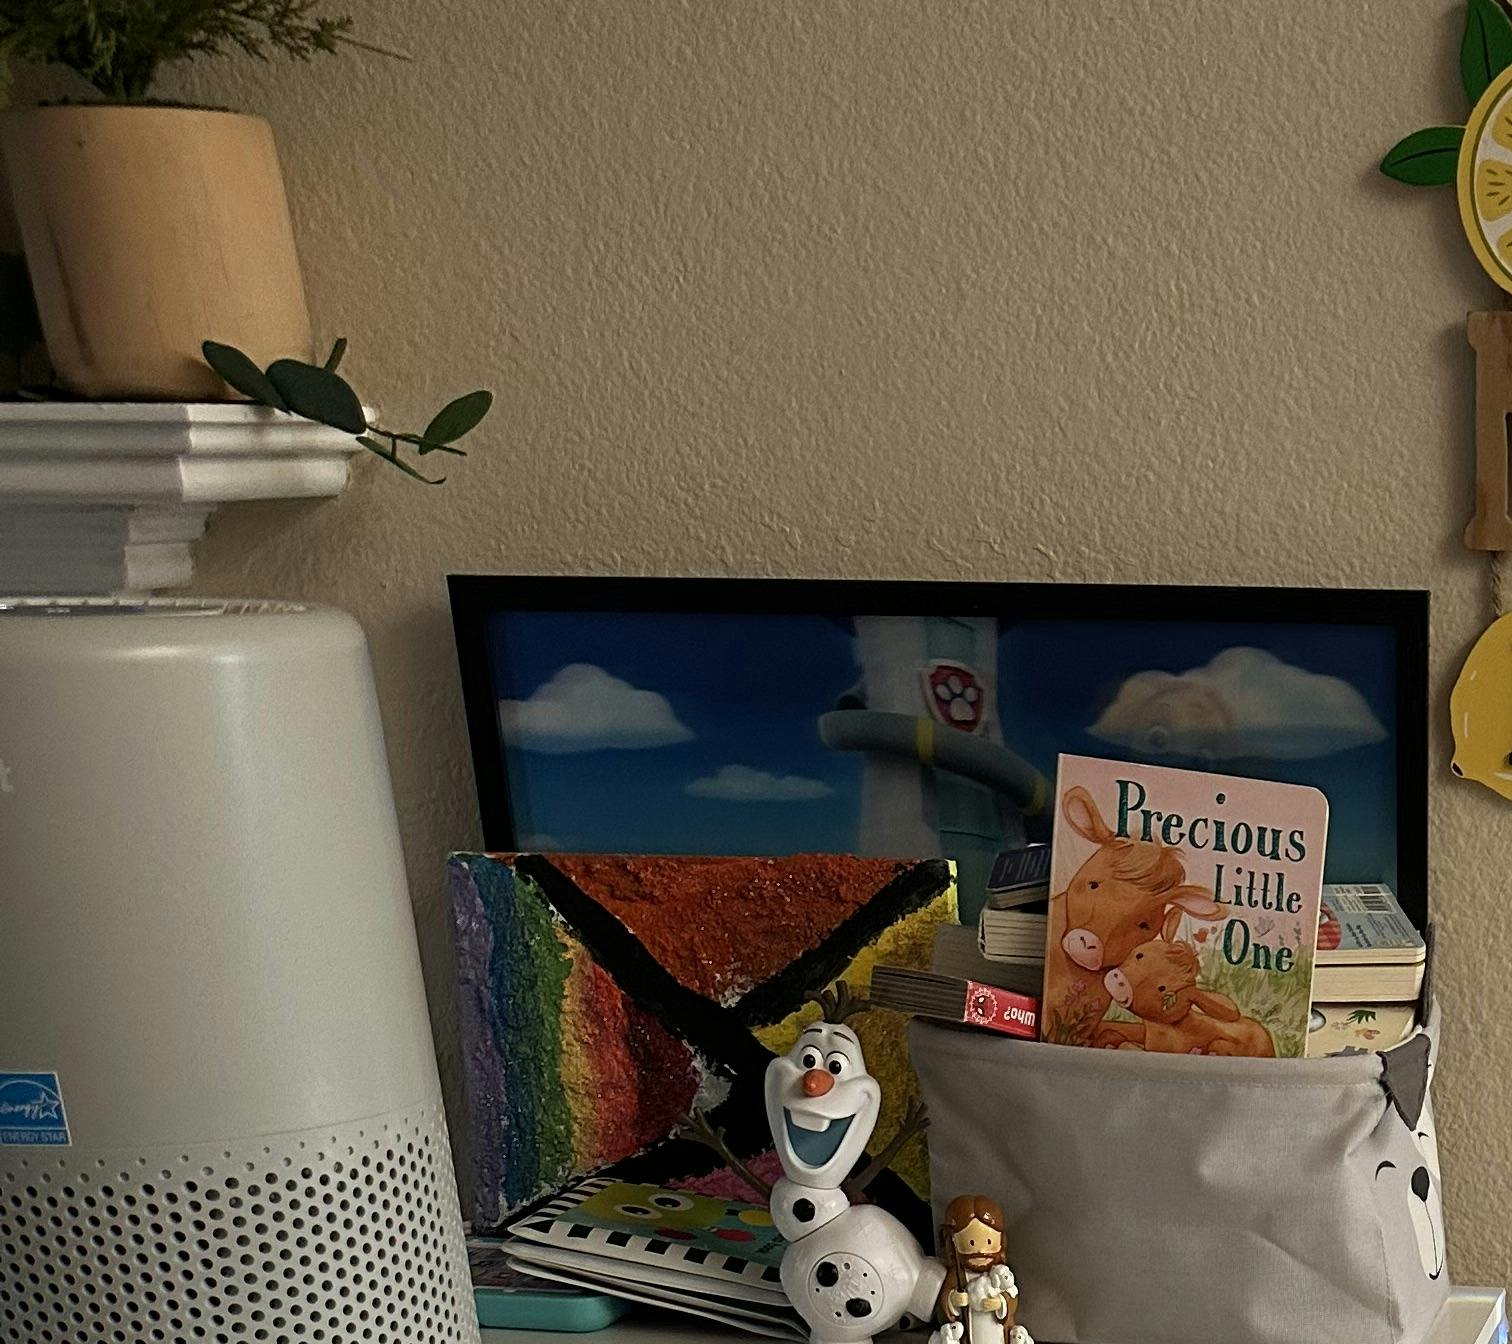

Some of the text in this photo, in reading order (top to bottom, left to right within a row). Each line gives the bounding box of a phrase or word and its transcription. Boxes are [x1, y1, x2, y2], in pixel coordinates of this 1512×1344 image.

[1113, 779, 1306, 863] Precious
[1213, 864, 1303, 915] Little
[1222, 918, 1294, 973] One
